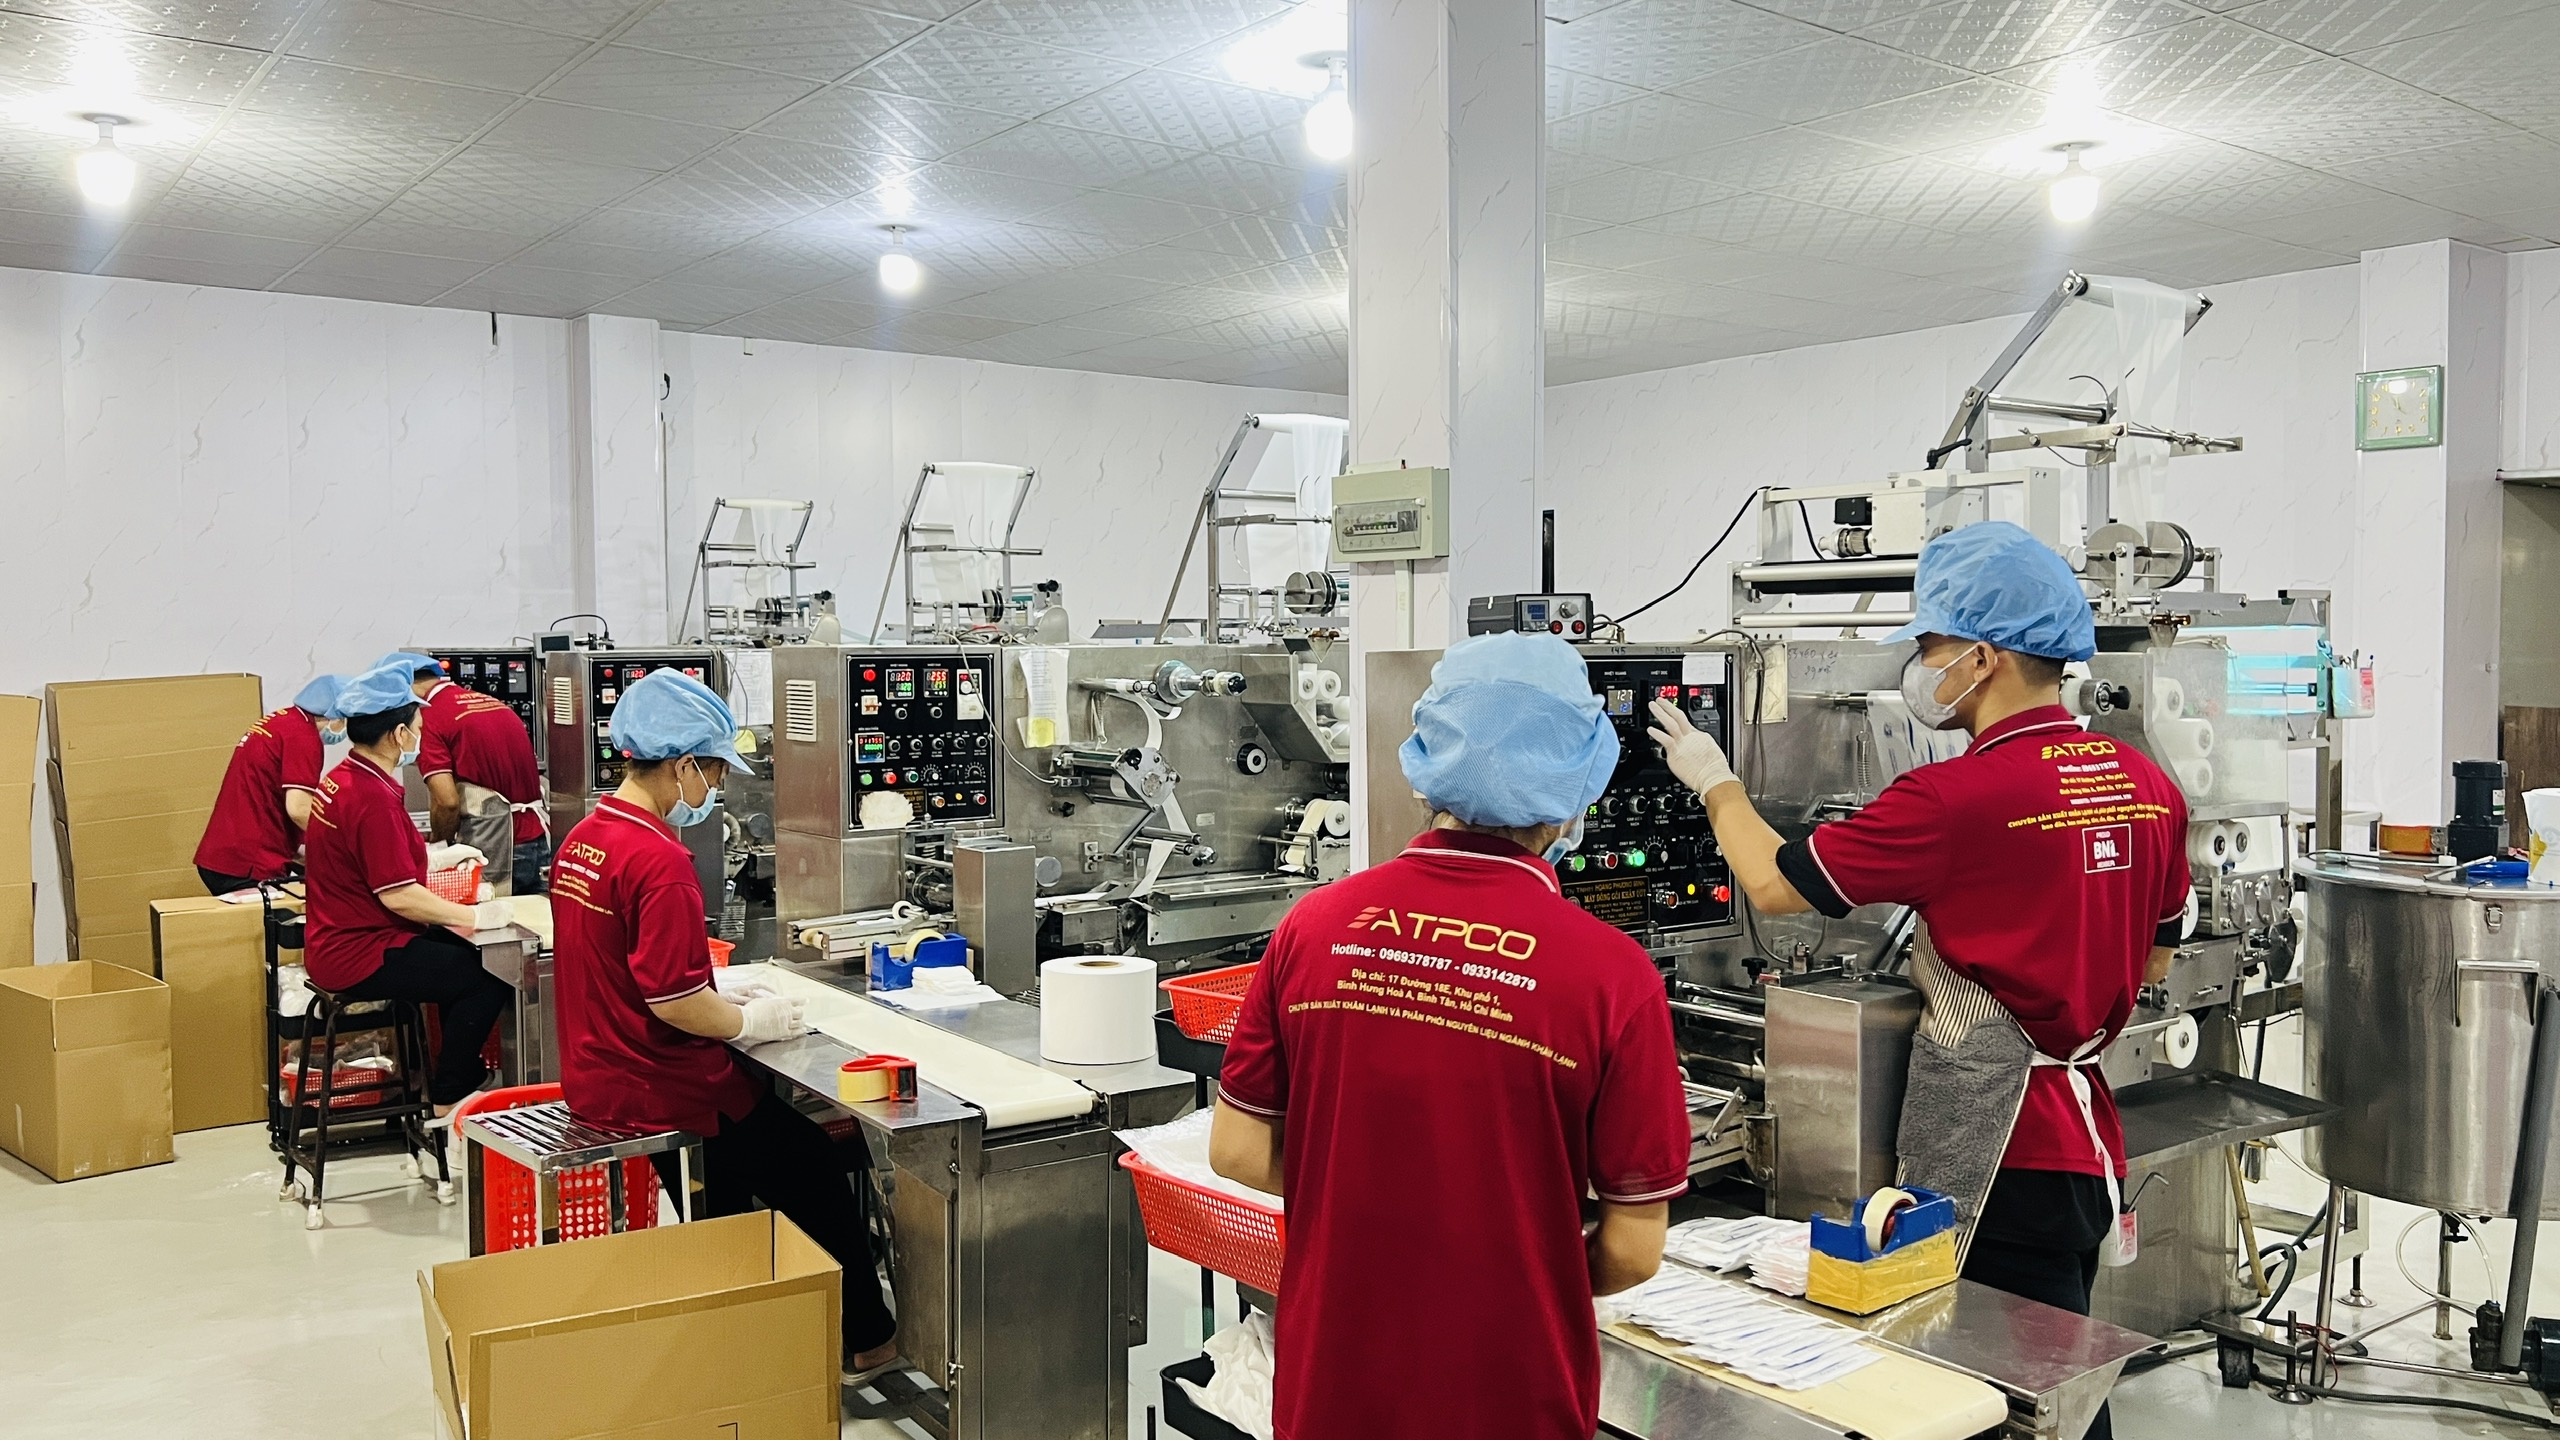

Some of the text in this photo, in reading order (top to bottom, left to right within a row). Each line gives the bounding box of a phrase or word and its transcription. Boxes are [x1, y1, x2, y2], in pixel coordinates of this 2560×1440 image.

[1370, 908, 1537, 960] ATPCO
[1331, 944, 1376, 958] Hotline:
[1379, 947, 1452, 970] 0969378787
[1462, 963, 1537, 991] 0933142879
[1352, 968, 1367, 980] Địa
[1388, 974, 1399, 984] 17
[1400, 976, 1432, 991] Đường
[1454, 986, 1473, 998] Khu
[1359, 982, 1384, 996] Hưng
[1405, 990, 1415, 1001] A,
[1474, 1003, 1489, 1015] Chí
[1490, 1007, 1513, 1022] Minh
[1366, 1004, 1388, 1015] LẠNH
